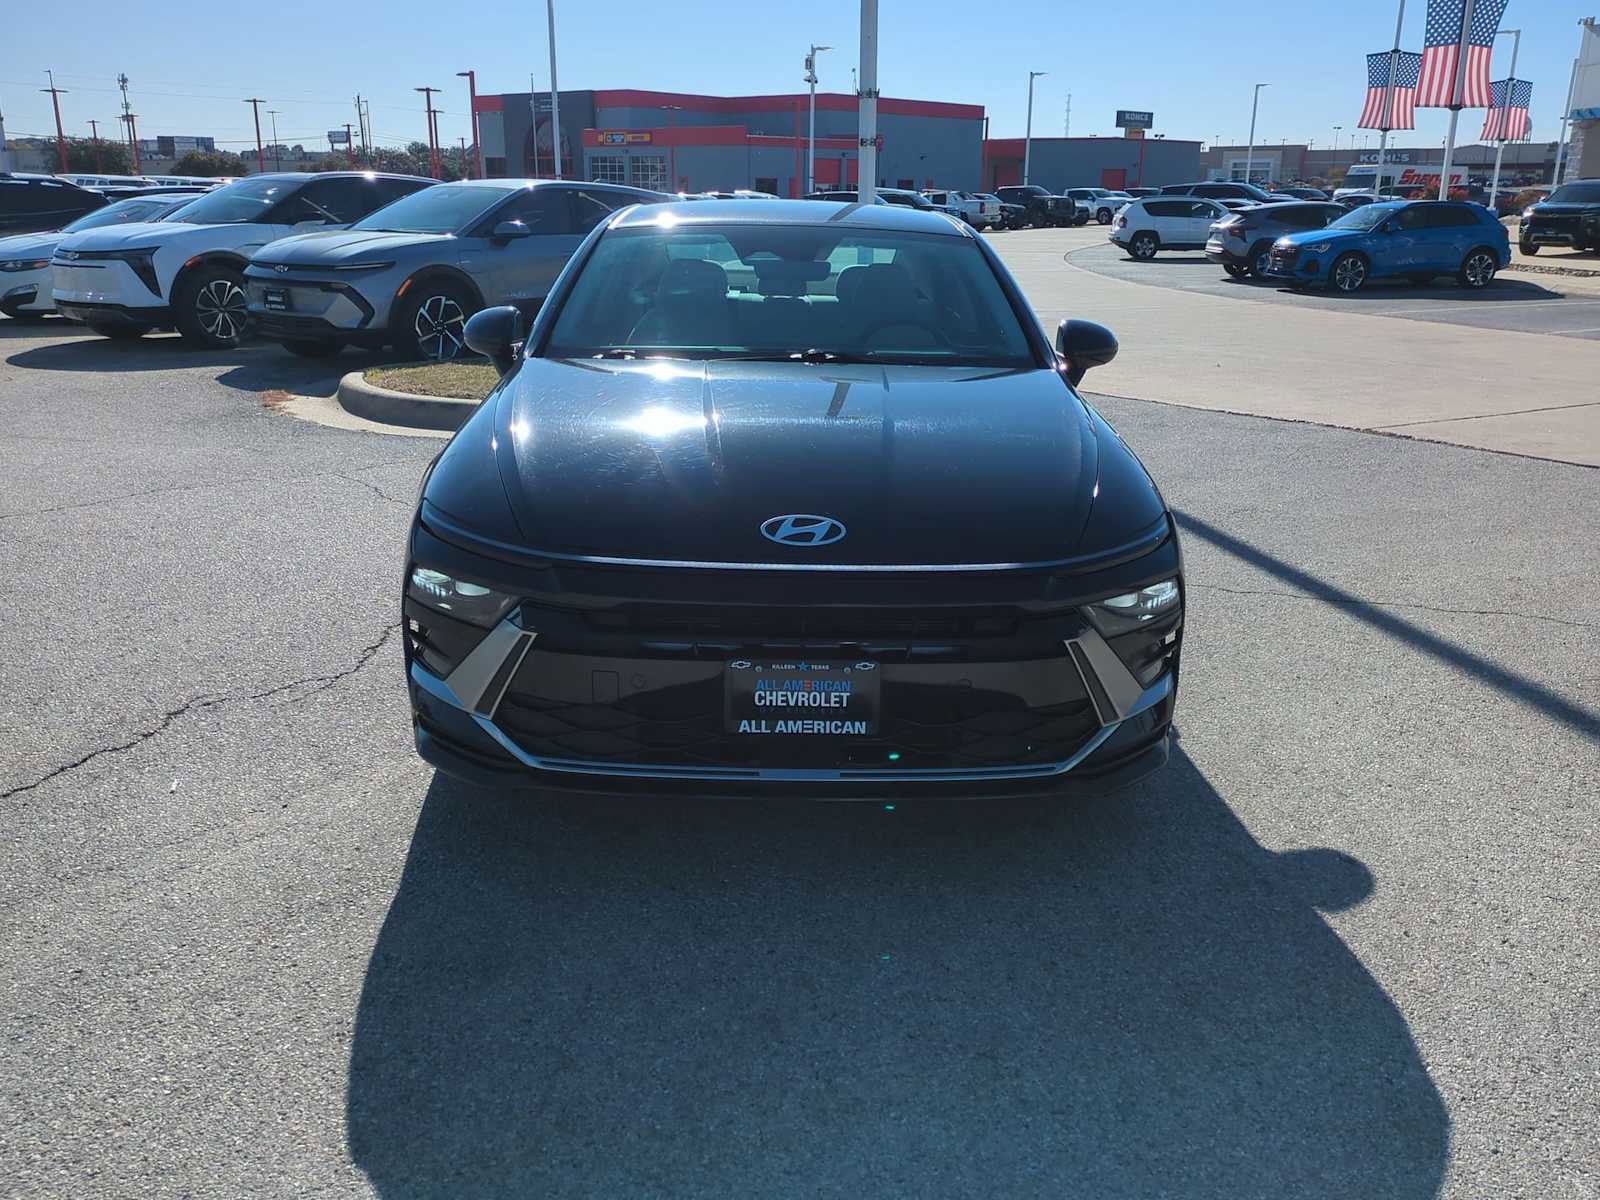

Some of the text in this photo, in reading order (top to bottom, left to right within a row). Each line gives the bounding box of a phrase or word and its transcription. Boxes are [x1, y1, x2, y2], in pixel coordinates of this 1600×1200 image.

[755, 679, 851, 692] ALL AMERICAN
[754, 691, 851, 708] CHEVROLET
[738, 720, 867, 734] ALL AMERICAN
